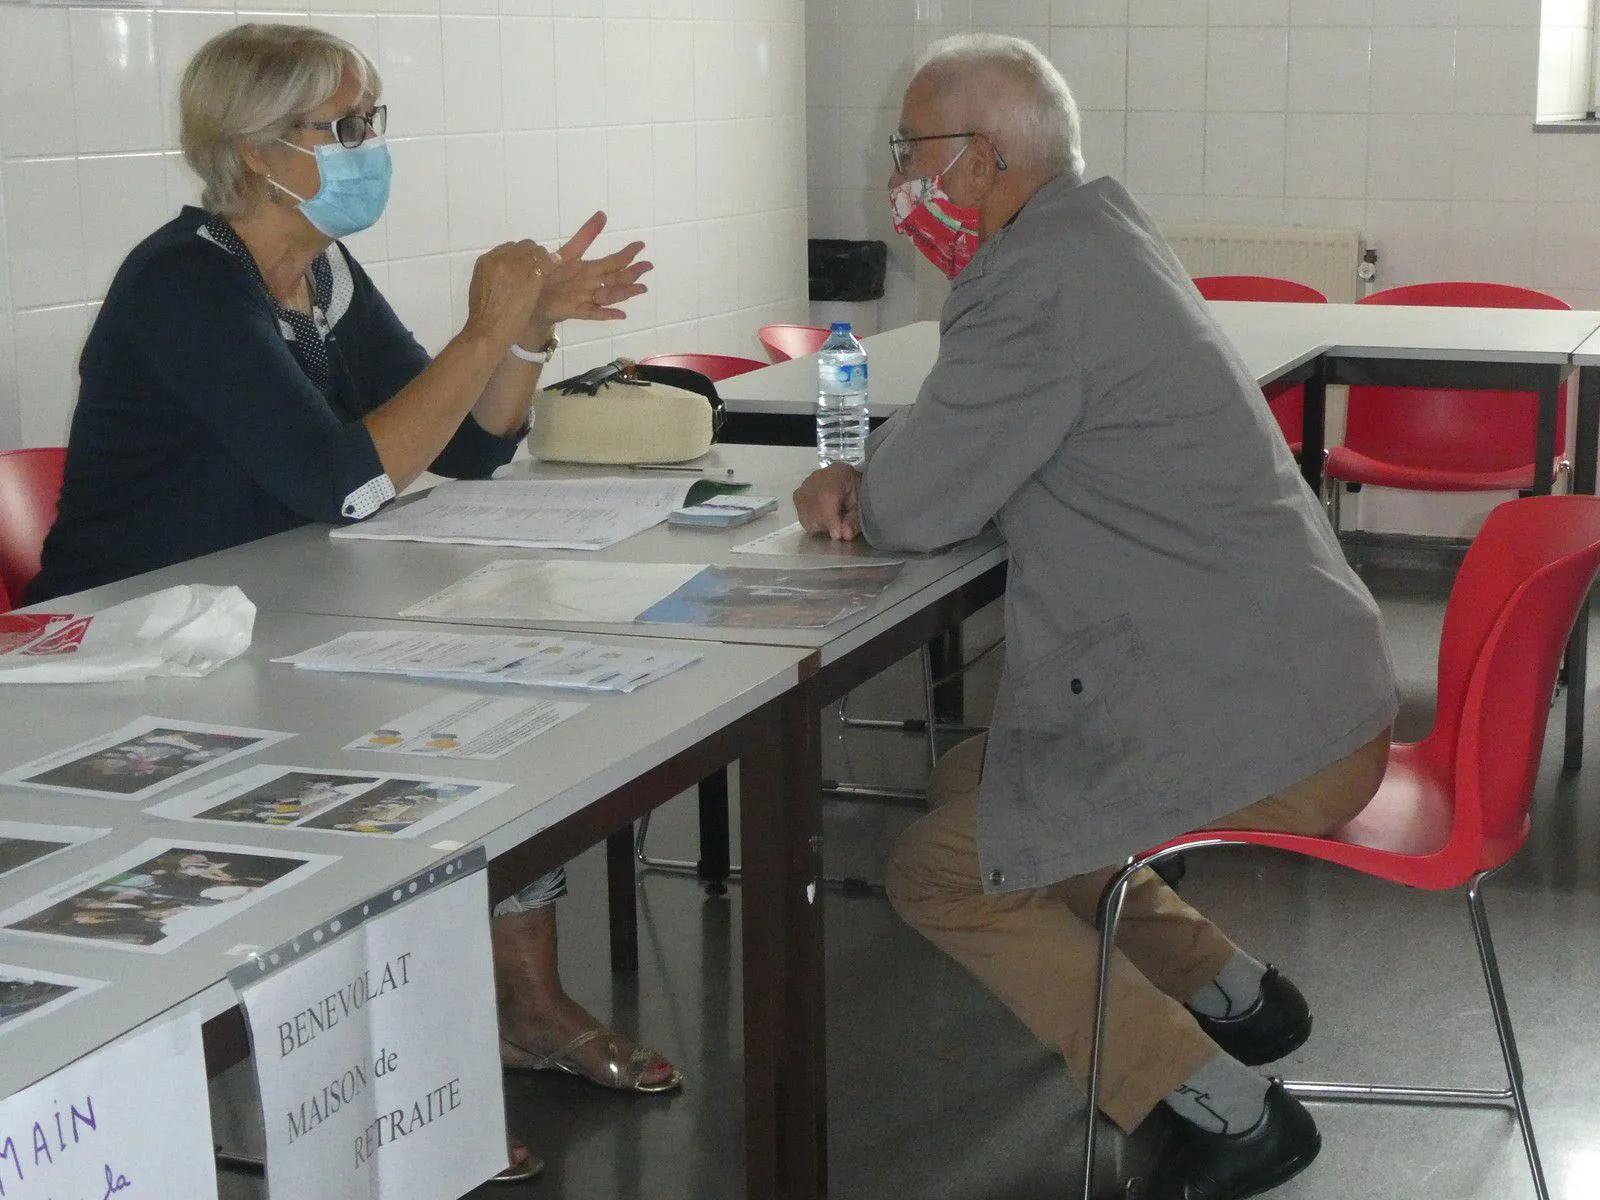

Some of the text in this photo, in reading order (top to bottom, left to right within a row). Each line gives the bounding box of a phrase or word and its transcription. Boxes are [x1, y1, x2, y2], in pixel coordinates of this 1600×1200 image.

[277, 953, 411, 1057] BENEVOLAT
[286, 1048, 398, 1145] MAISON de
[353, 1078, 463, 1169] RETRAITE
